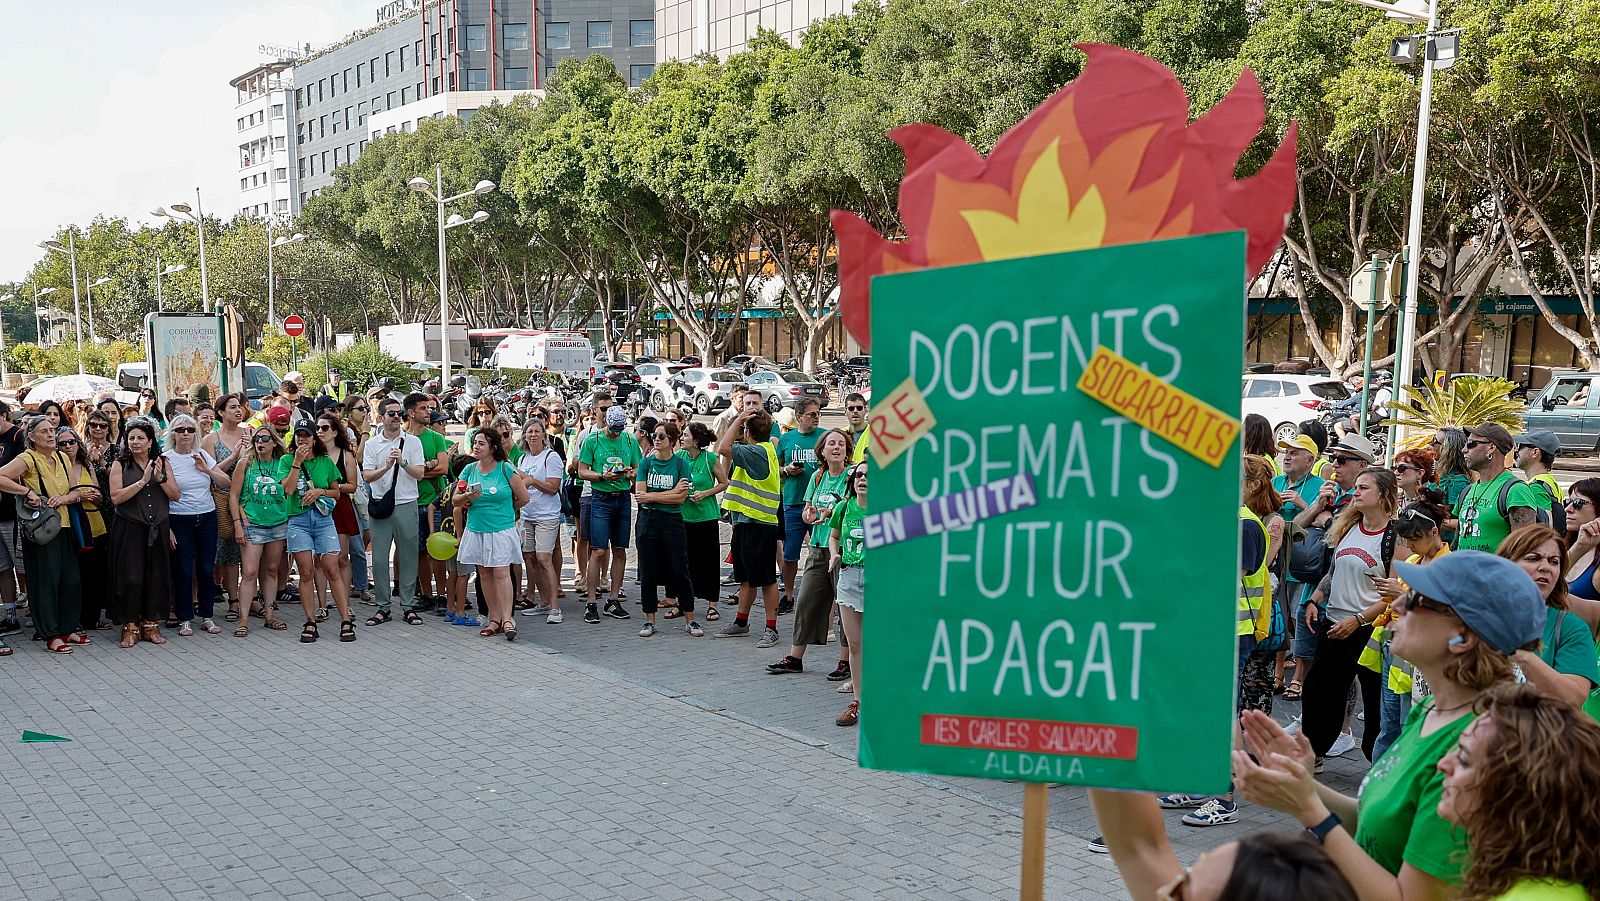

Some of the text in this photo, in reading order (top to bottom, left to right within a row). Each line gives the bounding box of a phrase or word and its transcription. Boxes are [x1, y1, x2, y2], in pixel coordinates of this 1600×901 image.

[1505, 302, 1536, 312] cajamar
[909, 303, 1182, 400] DOCENTS
[869, 392, 926, 456] RE
[1082, 354, 1233, 461] SOCARRATS
[904, 417, 1179, 501] CREMATS
[863, 473, 1038, 549] EN LLUITA
[938, 518, 1134, 600] FUTUR
[921, 618, 1157, 701] APAGAT
[934, 717, 1118, 754] IES CARLES SALVADOR
[983, 751, 1085, 778] ALDAIA
